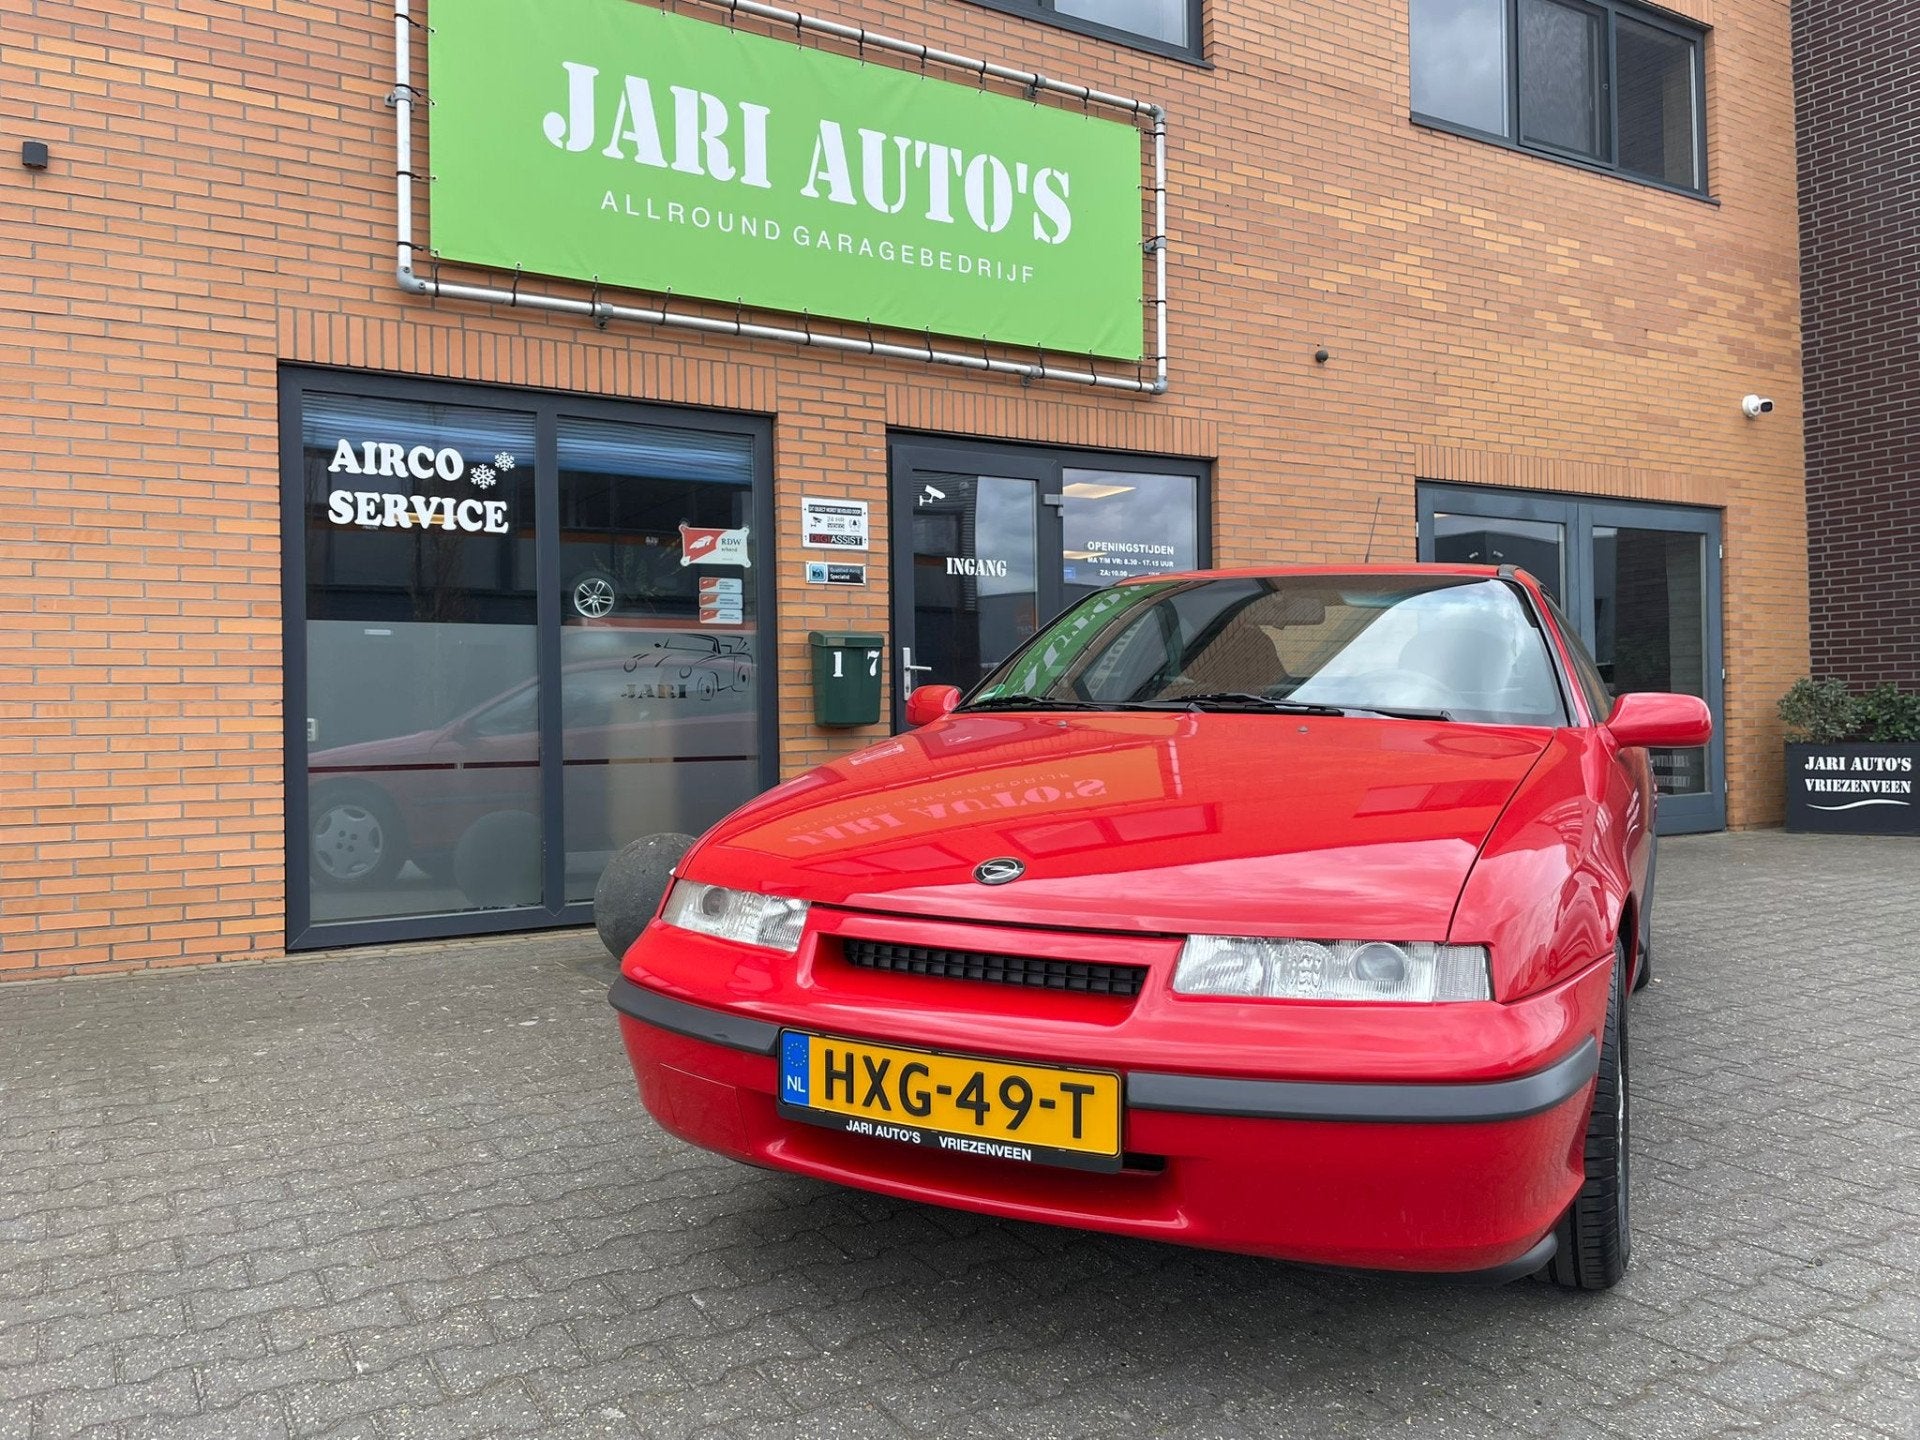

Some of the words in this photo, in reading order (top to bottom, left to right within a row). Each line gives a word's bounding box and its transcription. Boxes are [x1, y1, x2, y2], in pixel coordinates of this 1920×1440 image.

[542, 60, 773, 190] JARI
[800, 119, 1073, 245] AUTO'S
[601, 191, 781, 241] ALLROUND
[793, 225, 1035, 284] GARAGEBEDRIJF
[328, 438, 464, 481] AIRCO
[328, 490, 509, 534] SERVICE
[1087, 541, 1174, 555] OPENINGSTIJDEN
[946, 557, 1007, 577] INGANG
[832, 651, 844, 678] 1
[866, 650, 880, 677] 7
[620, 684, 688, 699] JARI
[1804, 756, 1846, 771] JARI
[1850, 756, 1912, 772] AUTO'S
[1805, 778, 1912, 794] VRIEZENVEEN
[787, 1074, 806, 1093] NL
[824, 1048, 1095, 1139] HXG-49-T
[846, 1120, 873, 1136] JARI
[875, 1126, 921, 1144] AUTO'S
[939, 1135, 1032, 1161] VRIEZENVEEN
